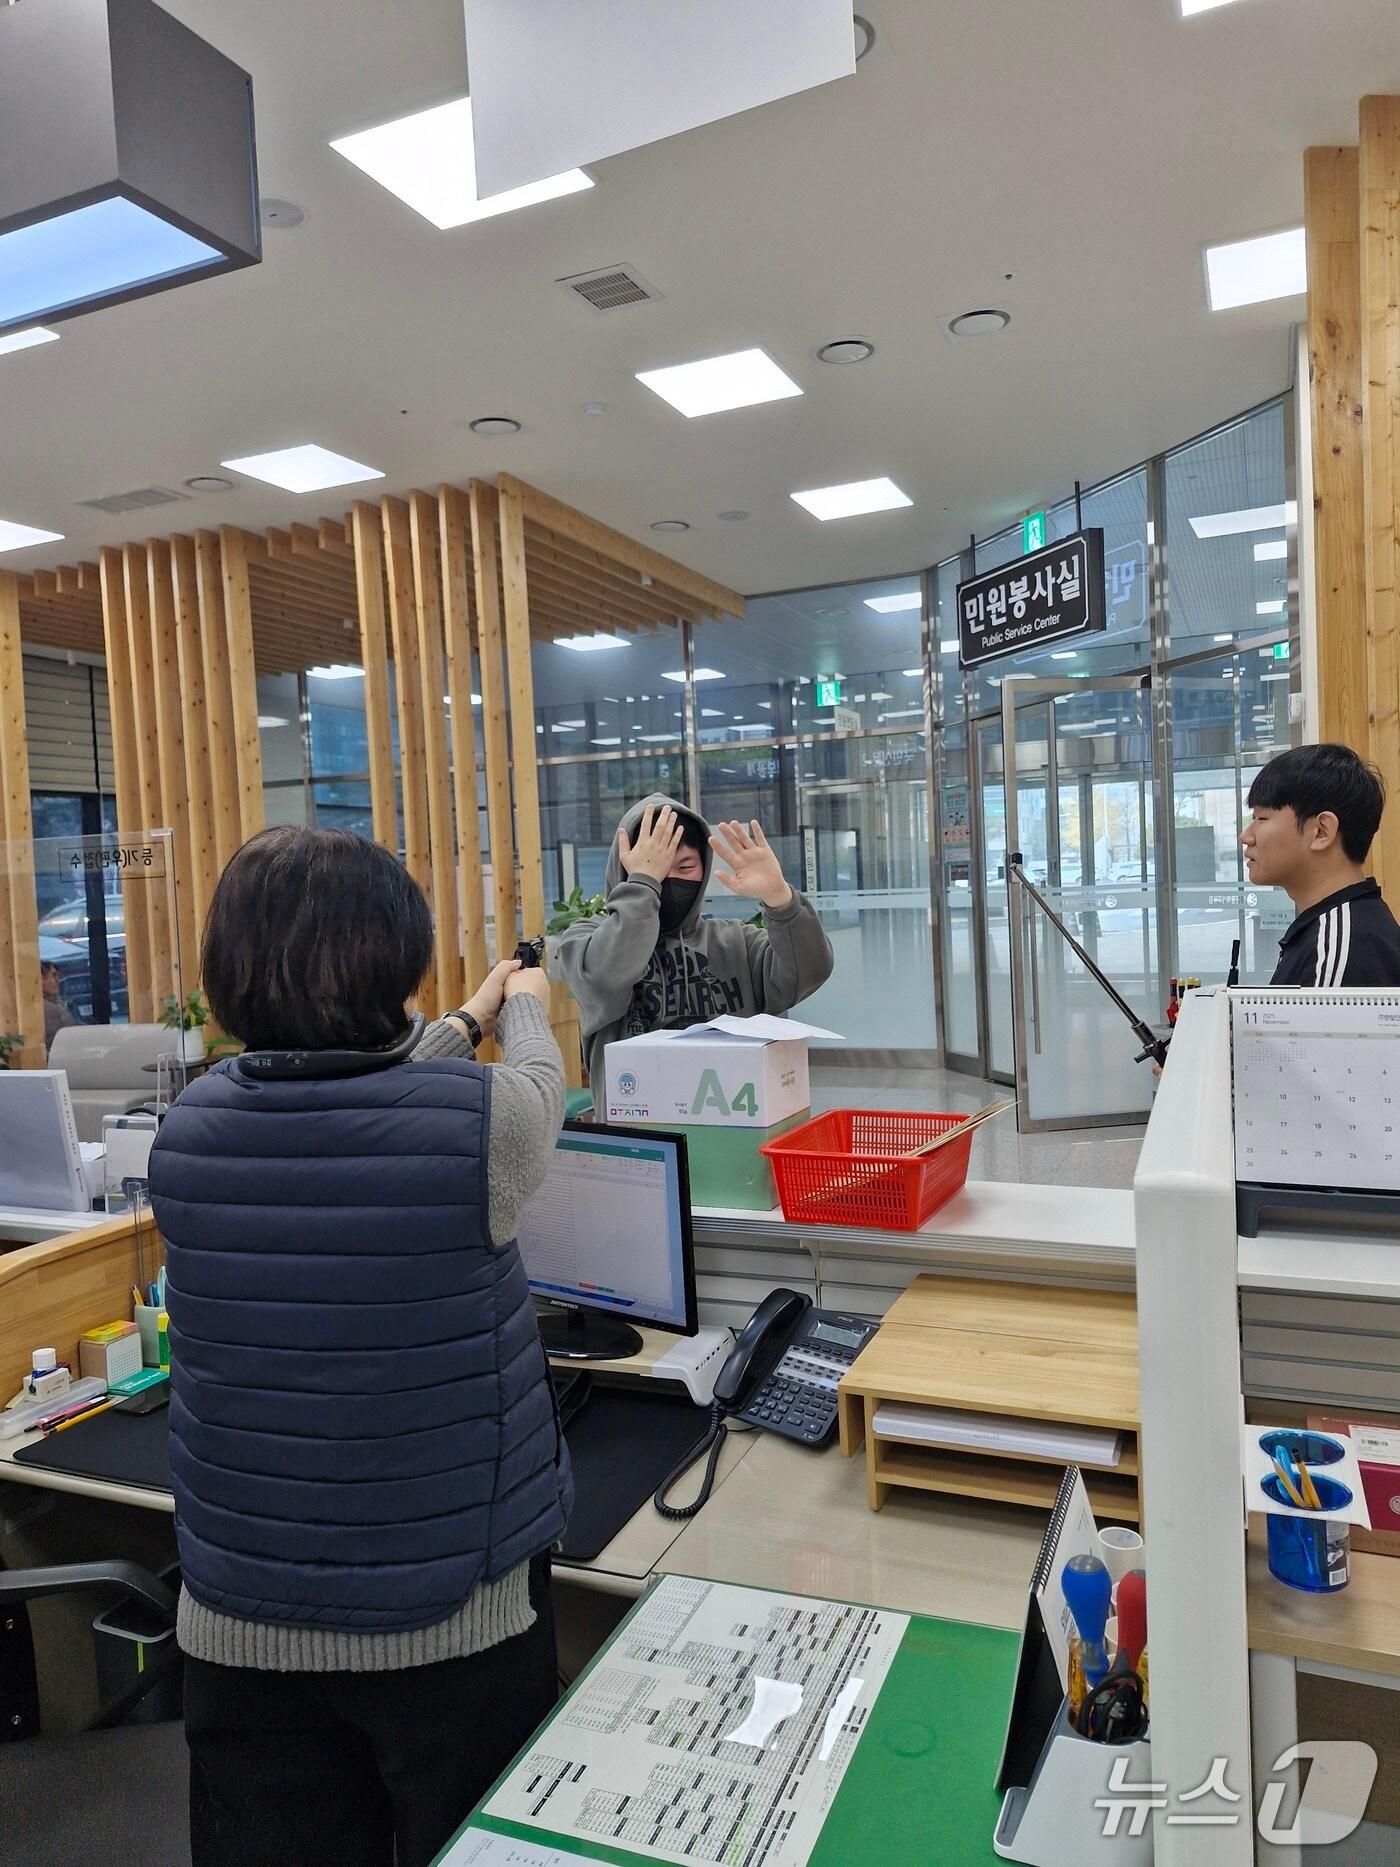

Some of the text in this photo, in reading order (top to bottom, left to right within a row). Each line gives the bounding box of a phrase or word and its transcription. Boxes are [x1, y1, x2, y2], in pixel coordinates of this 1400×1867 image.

[964, 554, 1081, 634] 민원봉사실
[981, 614, 1061, 648] Public Service Center
[1244, 1012, 1257, 1024] 11
[691, 1068, 760, 1118] A4
